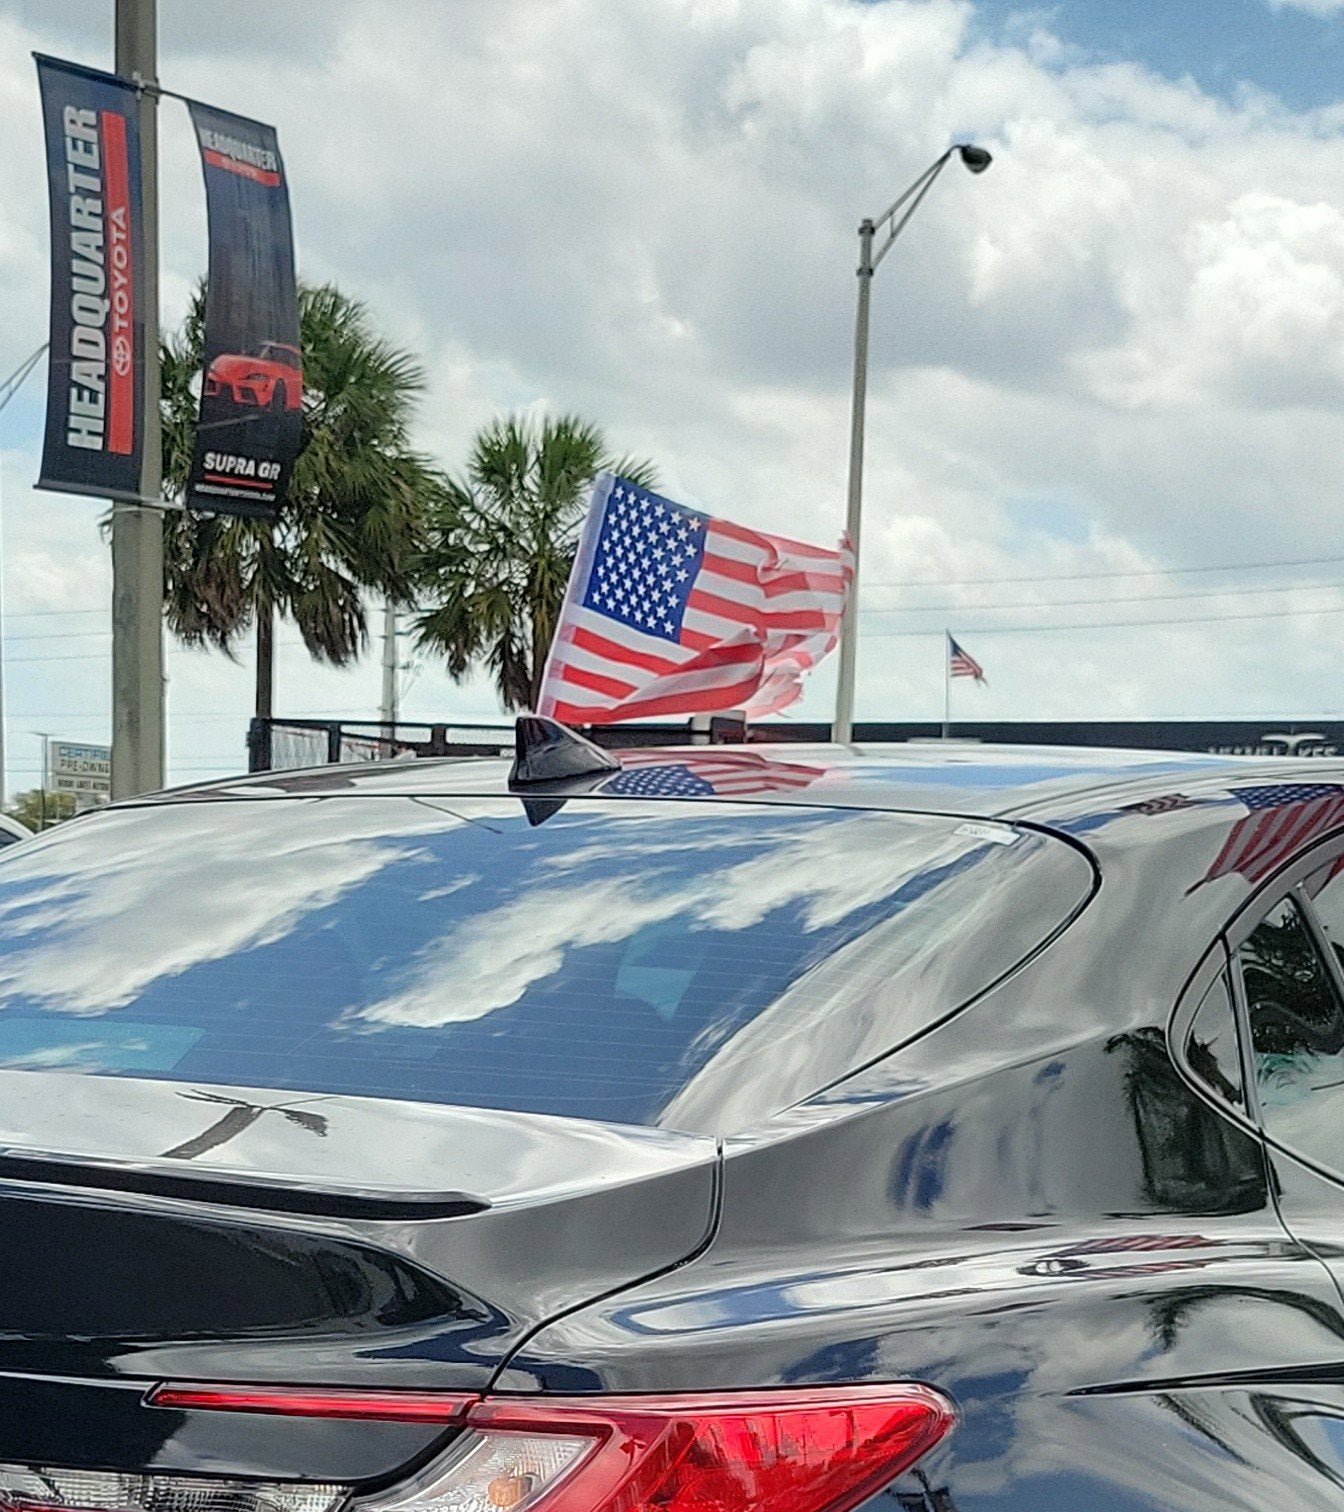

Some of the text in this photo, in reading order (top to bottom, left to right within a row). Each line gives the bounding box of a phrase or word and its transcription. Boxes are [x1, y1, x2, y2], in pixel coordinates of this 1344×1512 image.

[63, 104, 111, 452] HEADQUARTER
[108, 206, 130, 334] TOYOTA
[203, 451, 281, 480] SUPRA GR
[60, 758, 110, 774] PRE-OWNE
